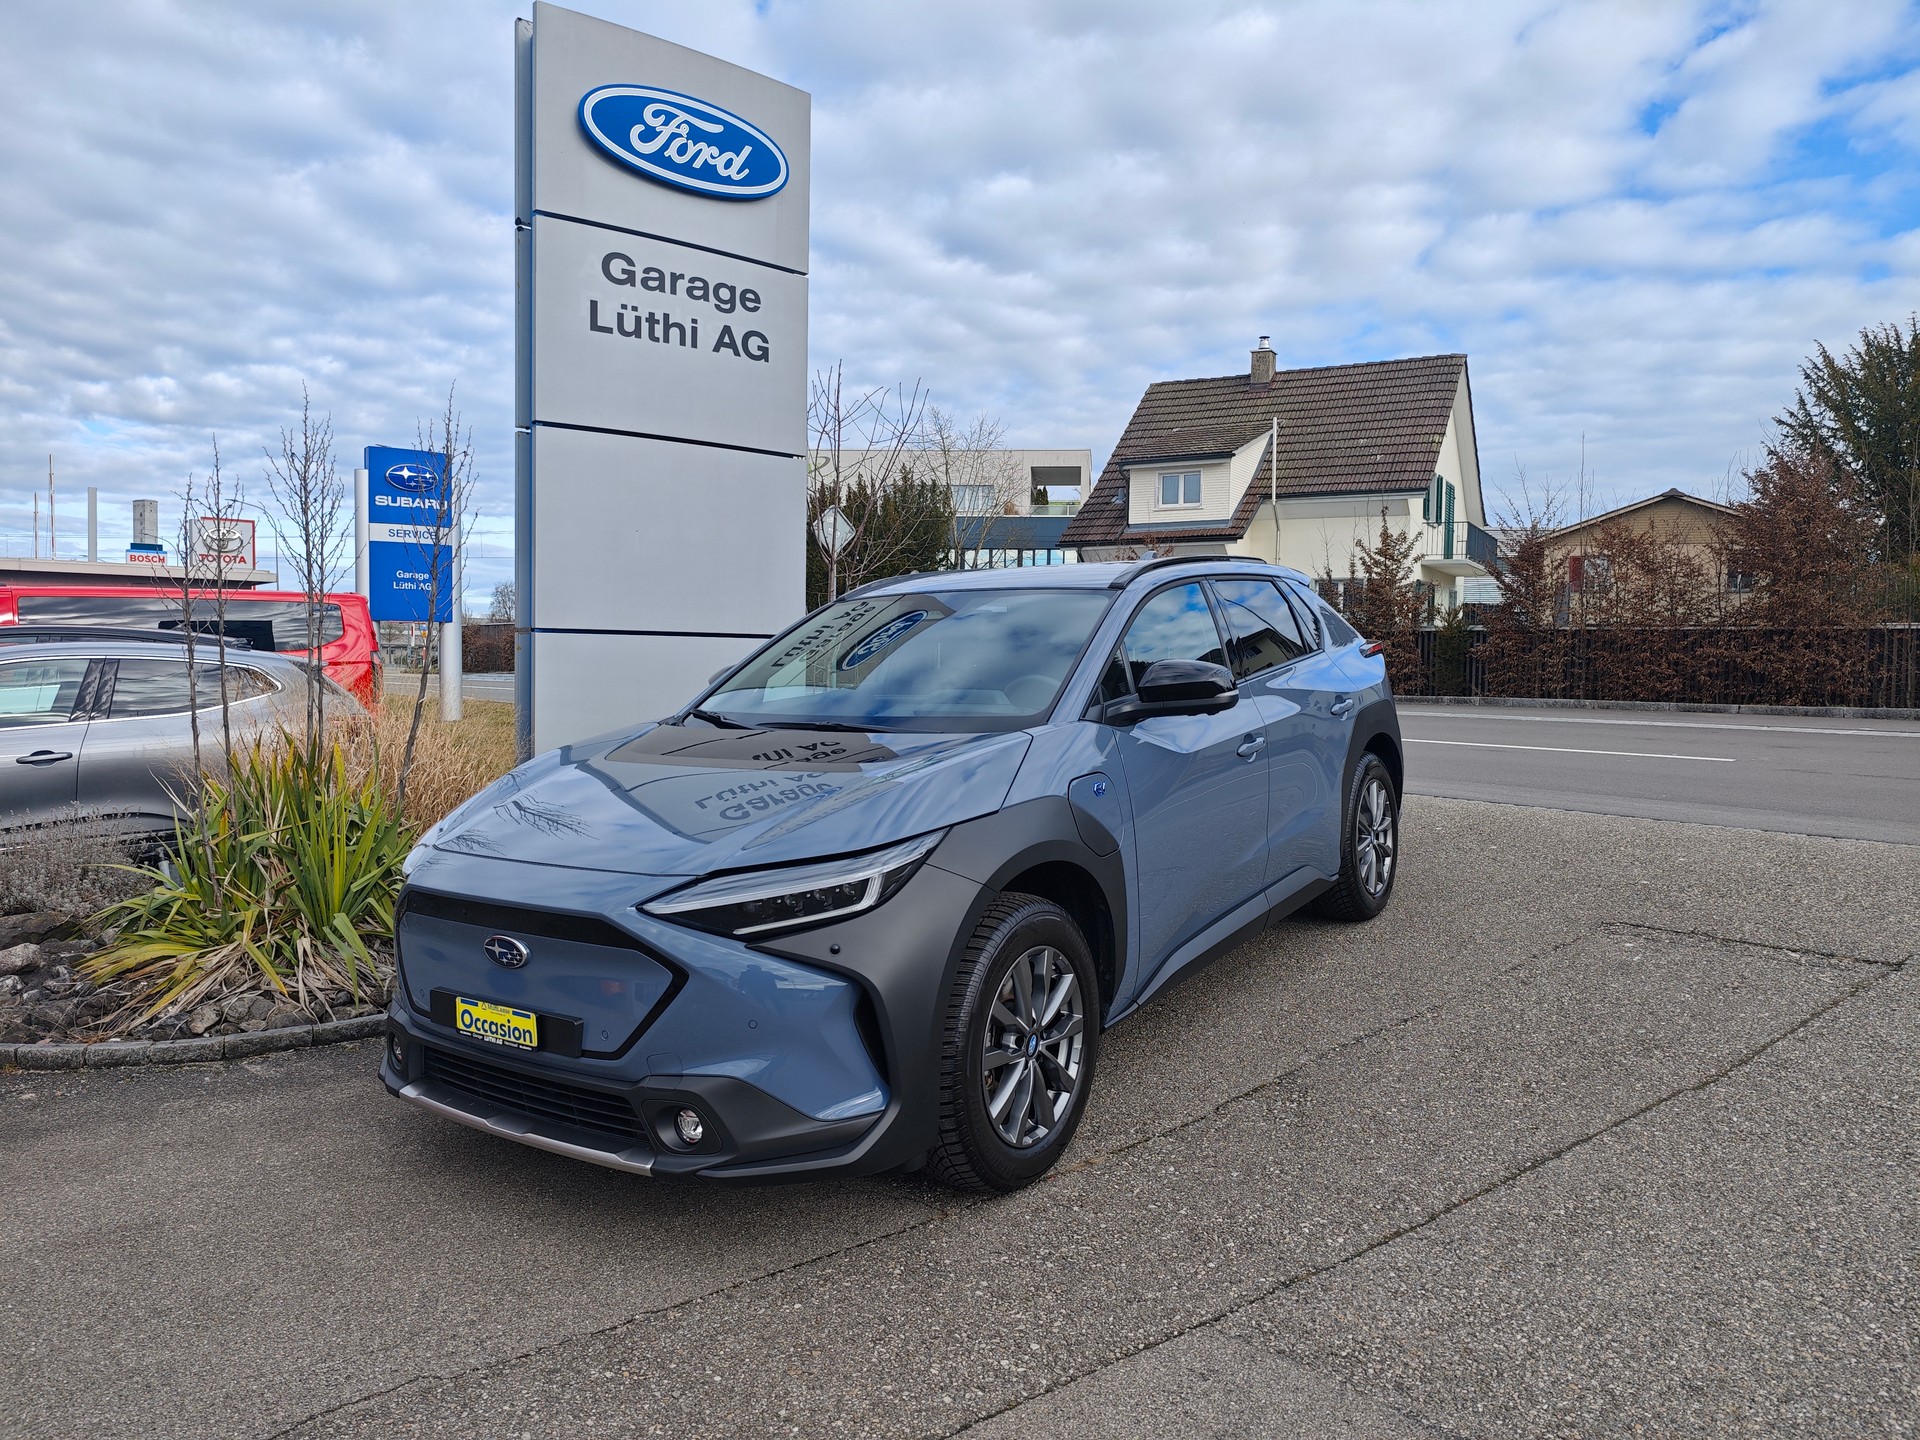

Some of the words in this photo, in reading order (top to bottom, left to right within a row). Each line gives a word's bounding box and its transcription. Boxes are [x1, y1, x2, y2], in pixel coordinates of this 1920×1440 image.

[630, 103, 752, 181] Ford
[601, 252, 762, 314] Garage
[589, 299, 699, 350] Lüthi
[712, 324, 770, 363] AG
[129, 554, 166, 564] BOSCH
[396, 570, 430, 581] Garage
[393, 581, 417, 591] Lüthi
[461, 1009, 533, 1044] Occasion
